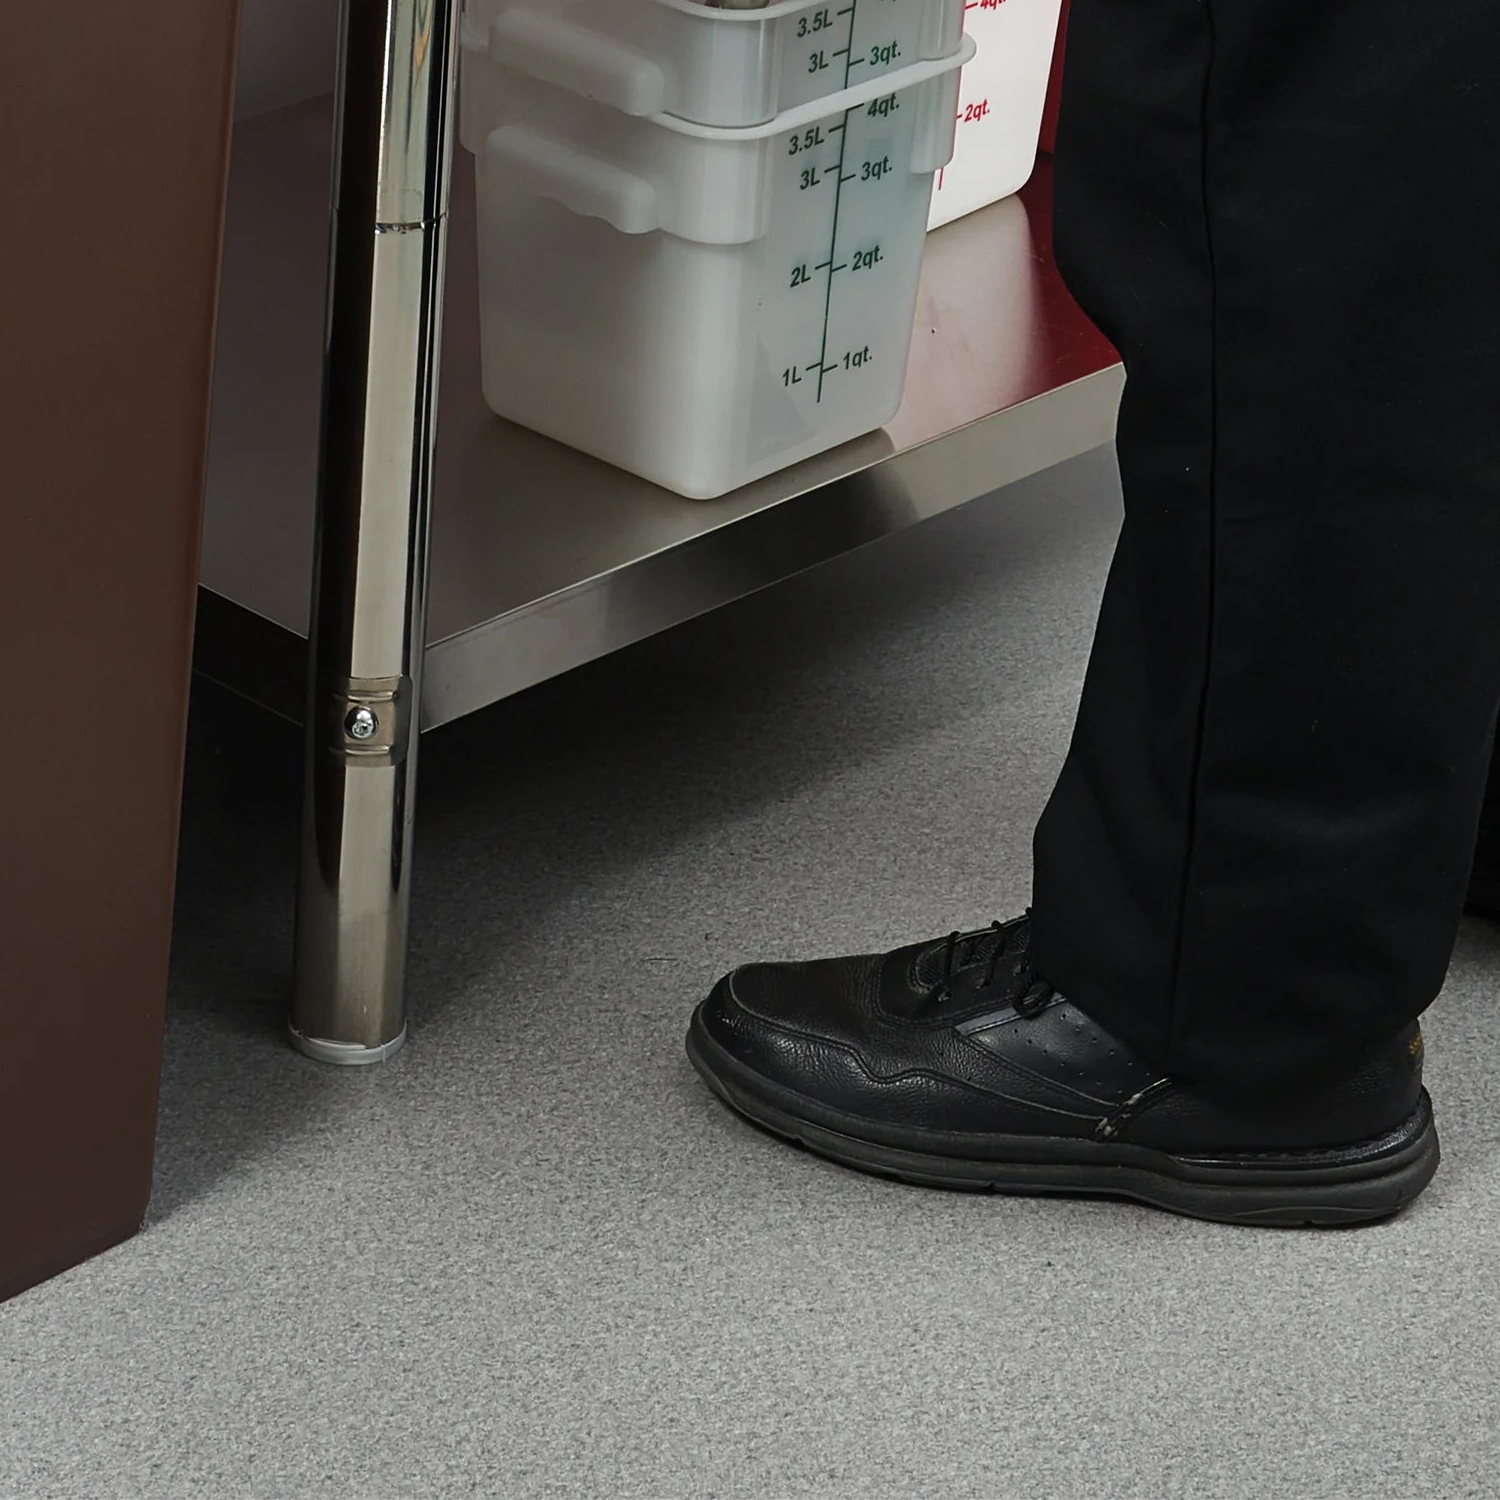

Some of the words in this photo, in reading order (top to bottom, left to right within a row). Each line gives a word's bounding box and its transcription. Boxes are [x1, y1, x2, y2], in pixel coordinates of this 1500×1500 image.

[796, 8, 833, 38] 3.5L
[808, 49, 830, 74] 3L
[870, 42, 901, 67] 3qt.
[868, 92, 900, 118] 4qt.
[964, 99, 990, 123] 2qt.
[788, 126, 825, 156] 3.5L
[799, 166, 821, 190] 3L
[861, 156, 893, 182] 3qt.
[852, 245, 884, 273] 2qt.
[790, 265, 812, 288] 2L
[842, 346, 873, 373] 1qt.
[782, 365, 802, 388] 1L
